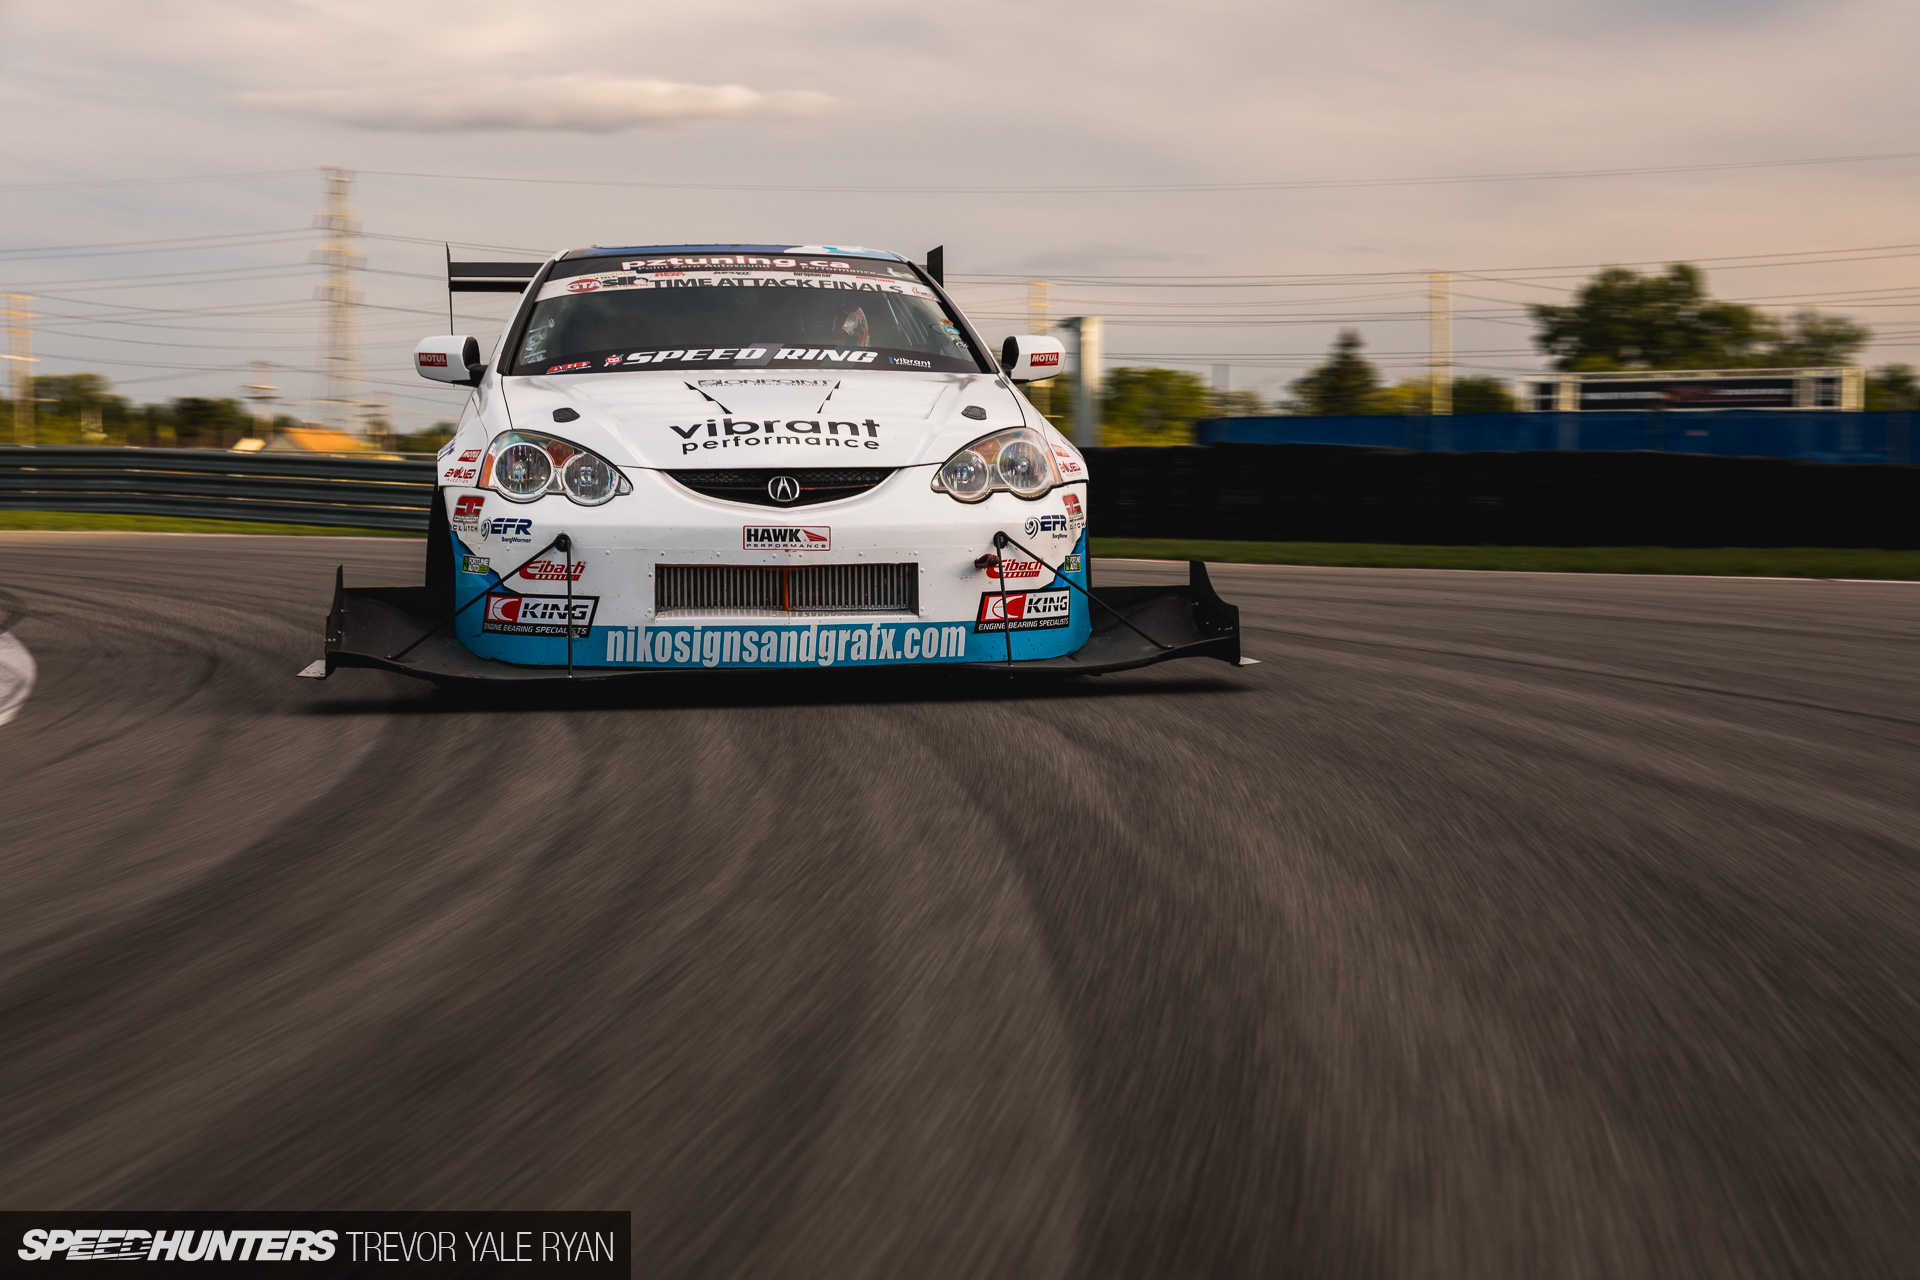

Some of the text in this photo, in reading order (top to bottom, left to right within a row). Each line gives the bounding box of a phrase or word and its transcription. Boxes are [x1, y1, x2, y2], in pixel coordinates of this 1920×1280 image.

[622, 256, 850, 270] pztuning.ca
[567, 281, 602, 291] GTA
[648, 278, 716, 288] TIME
[716, 277, 813, 288] ATTACK
[818, 280, 904, 294] FINALS
[420, 354, 446, 363] MOTUL
[623, 348, 878, 365] SPEED RING
[893, 357, 931, 367] vibrant
[1032, 353, 1058, 363] MOTUL
[669, 418, 880, 439] vibrant
[682, 435, 880, 455] performance
[491, 518, 532, 535] EFR
[1040, 515, 1067, 531] EFR
[746, 528, 801, 543] HAWK
[522, 603, 589, 620] KING
[1027, 596, 1067, 614] KING
[484, 622, 587, 635] ENGINE BEARING SPECIALSTS
[979, 618, 1069, 631] ENGINE BEARING SPECIALISTS
[606, 623, 966, 667] nikosignsandgrafx.com
